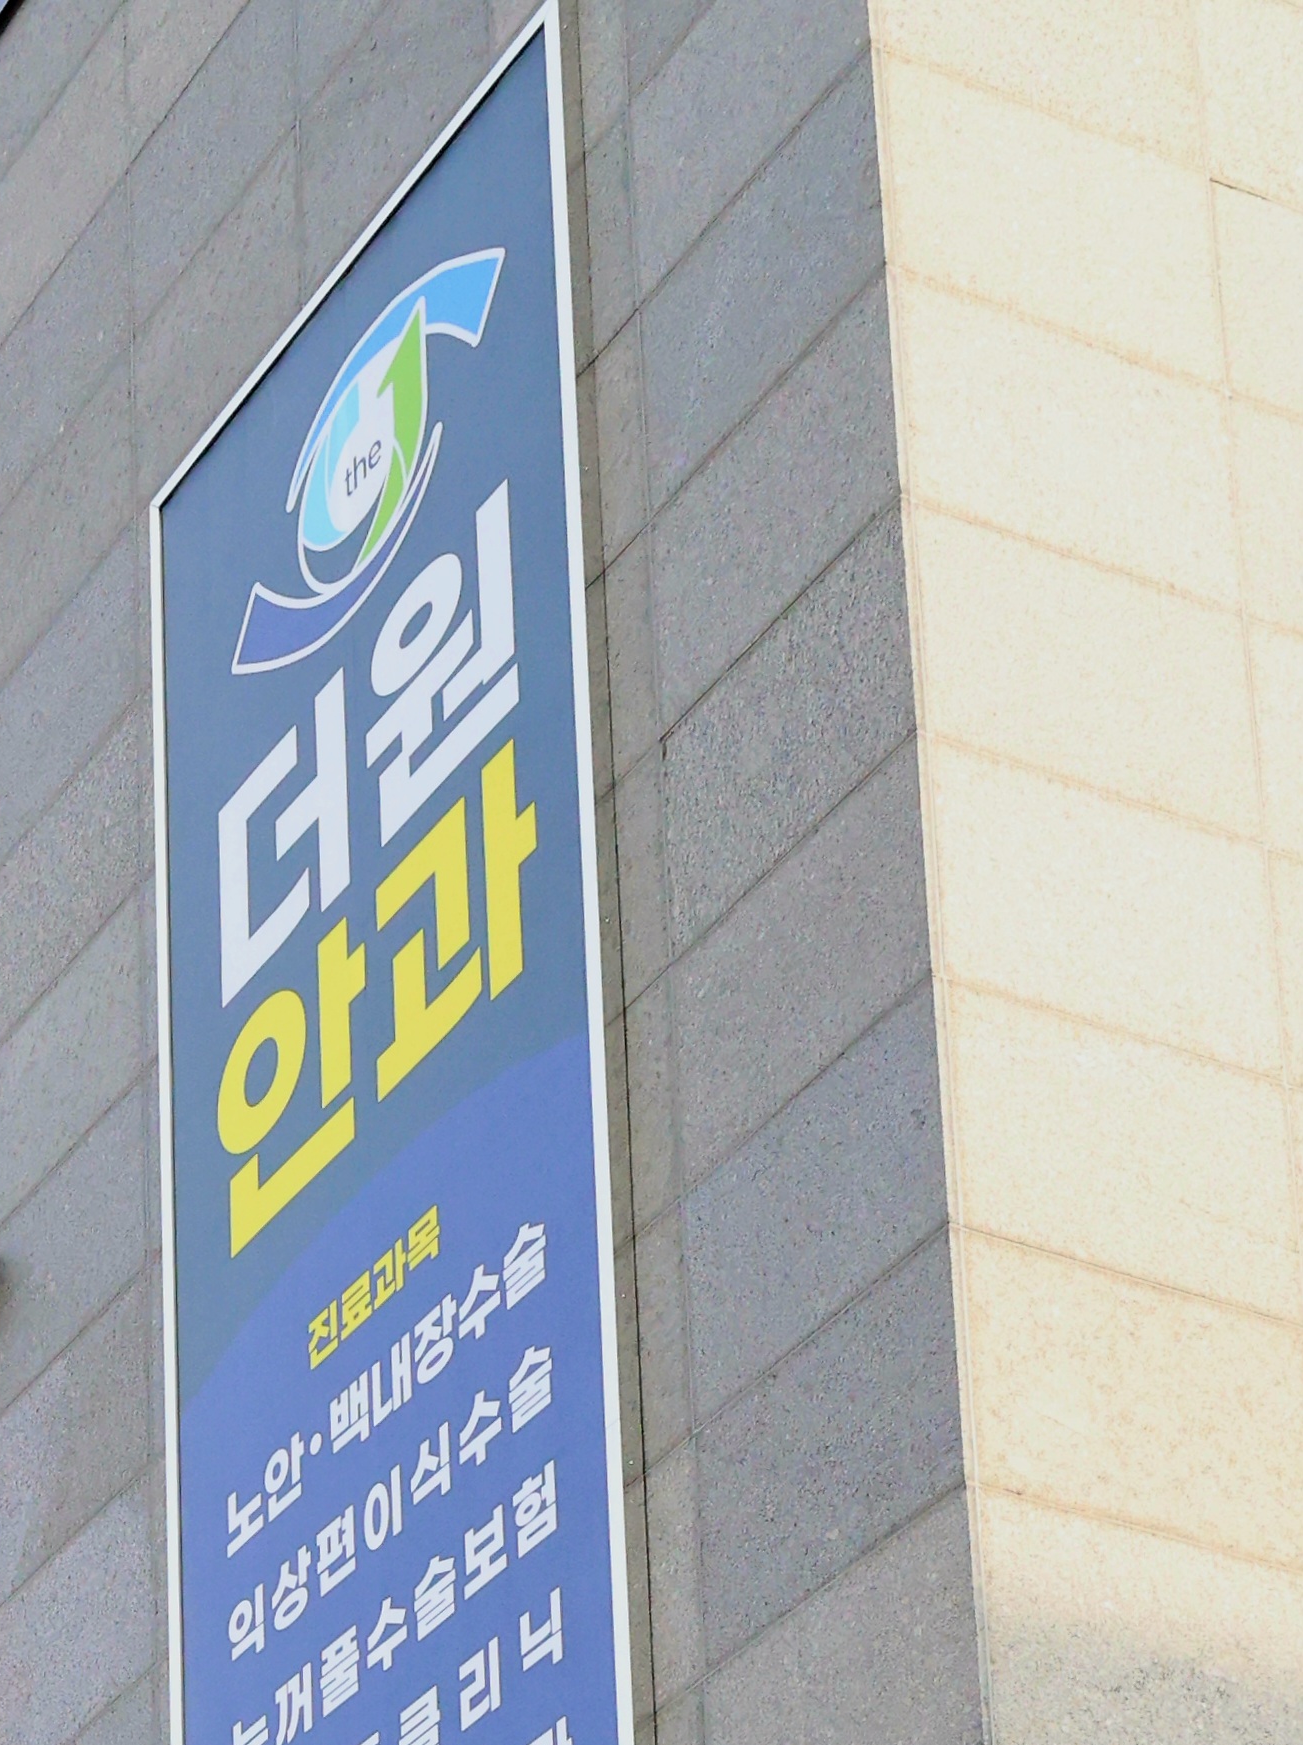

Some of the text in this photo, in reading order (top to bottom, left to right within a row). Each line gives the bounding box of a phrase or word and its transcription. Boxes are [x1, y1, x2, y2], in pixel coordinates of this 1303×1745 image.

[343, 438, 382, 497] the
[216, 478, 520, 1006] 더원
[215, 738, 539, 1258] 안과
[308, 1205, 440, 1369] 진료과목
[227, 1344, 553, 1661] 익상편이식수술
